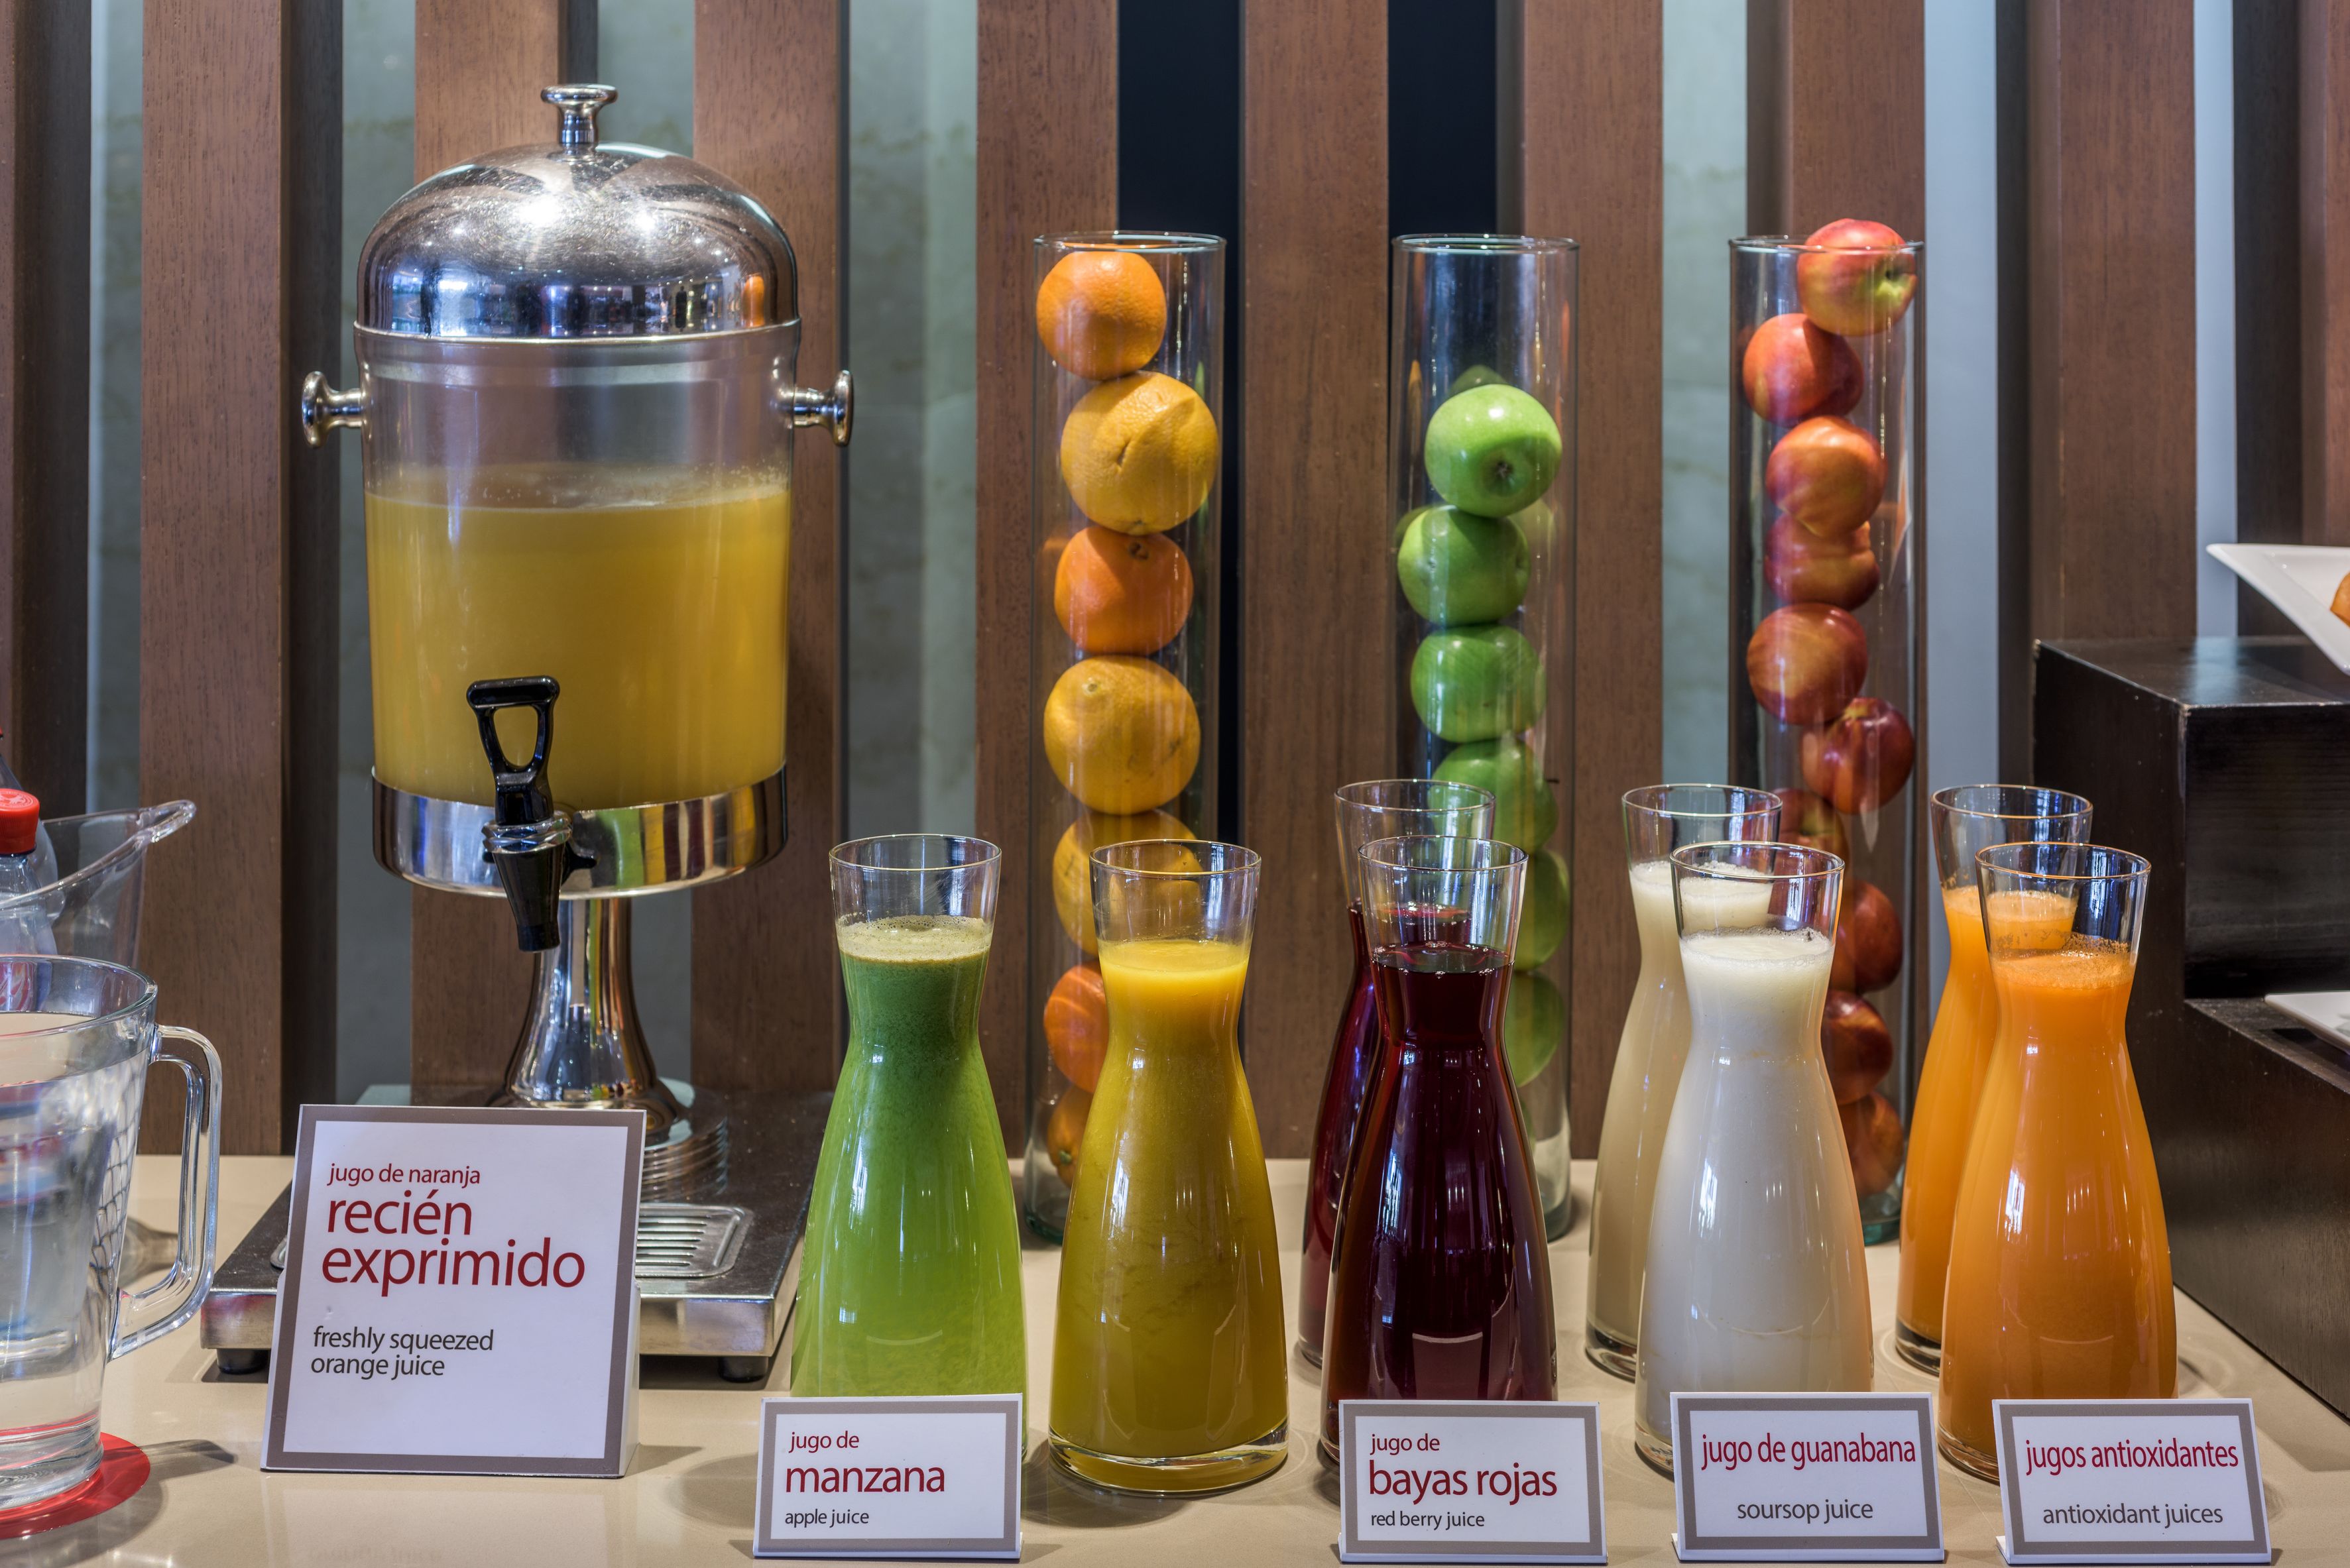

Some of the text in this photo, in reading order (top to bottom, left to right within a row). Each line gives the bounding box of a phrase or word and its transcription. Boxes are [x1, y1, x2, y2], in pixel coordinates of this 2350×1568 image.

[326, 1162, 481, 1189] jugo de naranja
[327, 1189, 473, 1235] recién
[322, 1237, 585, 1298] exprimido
[313, 1325, 494, 1355] freshly squeezed
[310, 1353, 445, 1381] orange juice
[788, 1430, 860, 1453] jugo de
[1370, 1433, 1440, 1456] jugo de
[1701, 1432, 1916, 1471] jugo de guanabana
[2025, 1437, 2239, 1476] jugos antioxidantes
[786, 1467, 945, 1493] manzana
[1369, 1459, 1558, 1506] bayas rojas
[785, 1508, 870, 1528] apple juice
[1371, 1510, 1485, 1531] red berry juice
[1737, 1498, 1873, 1524] soursop juice
[2043, 1502, 2223, 1529] antioxidant juices
